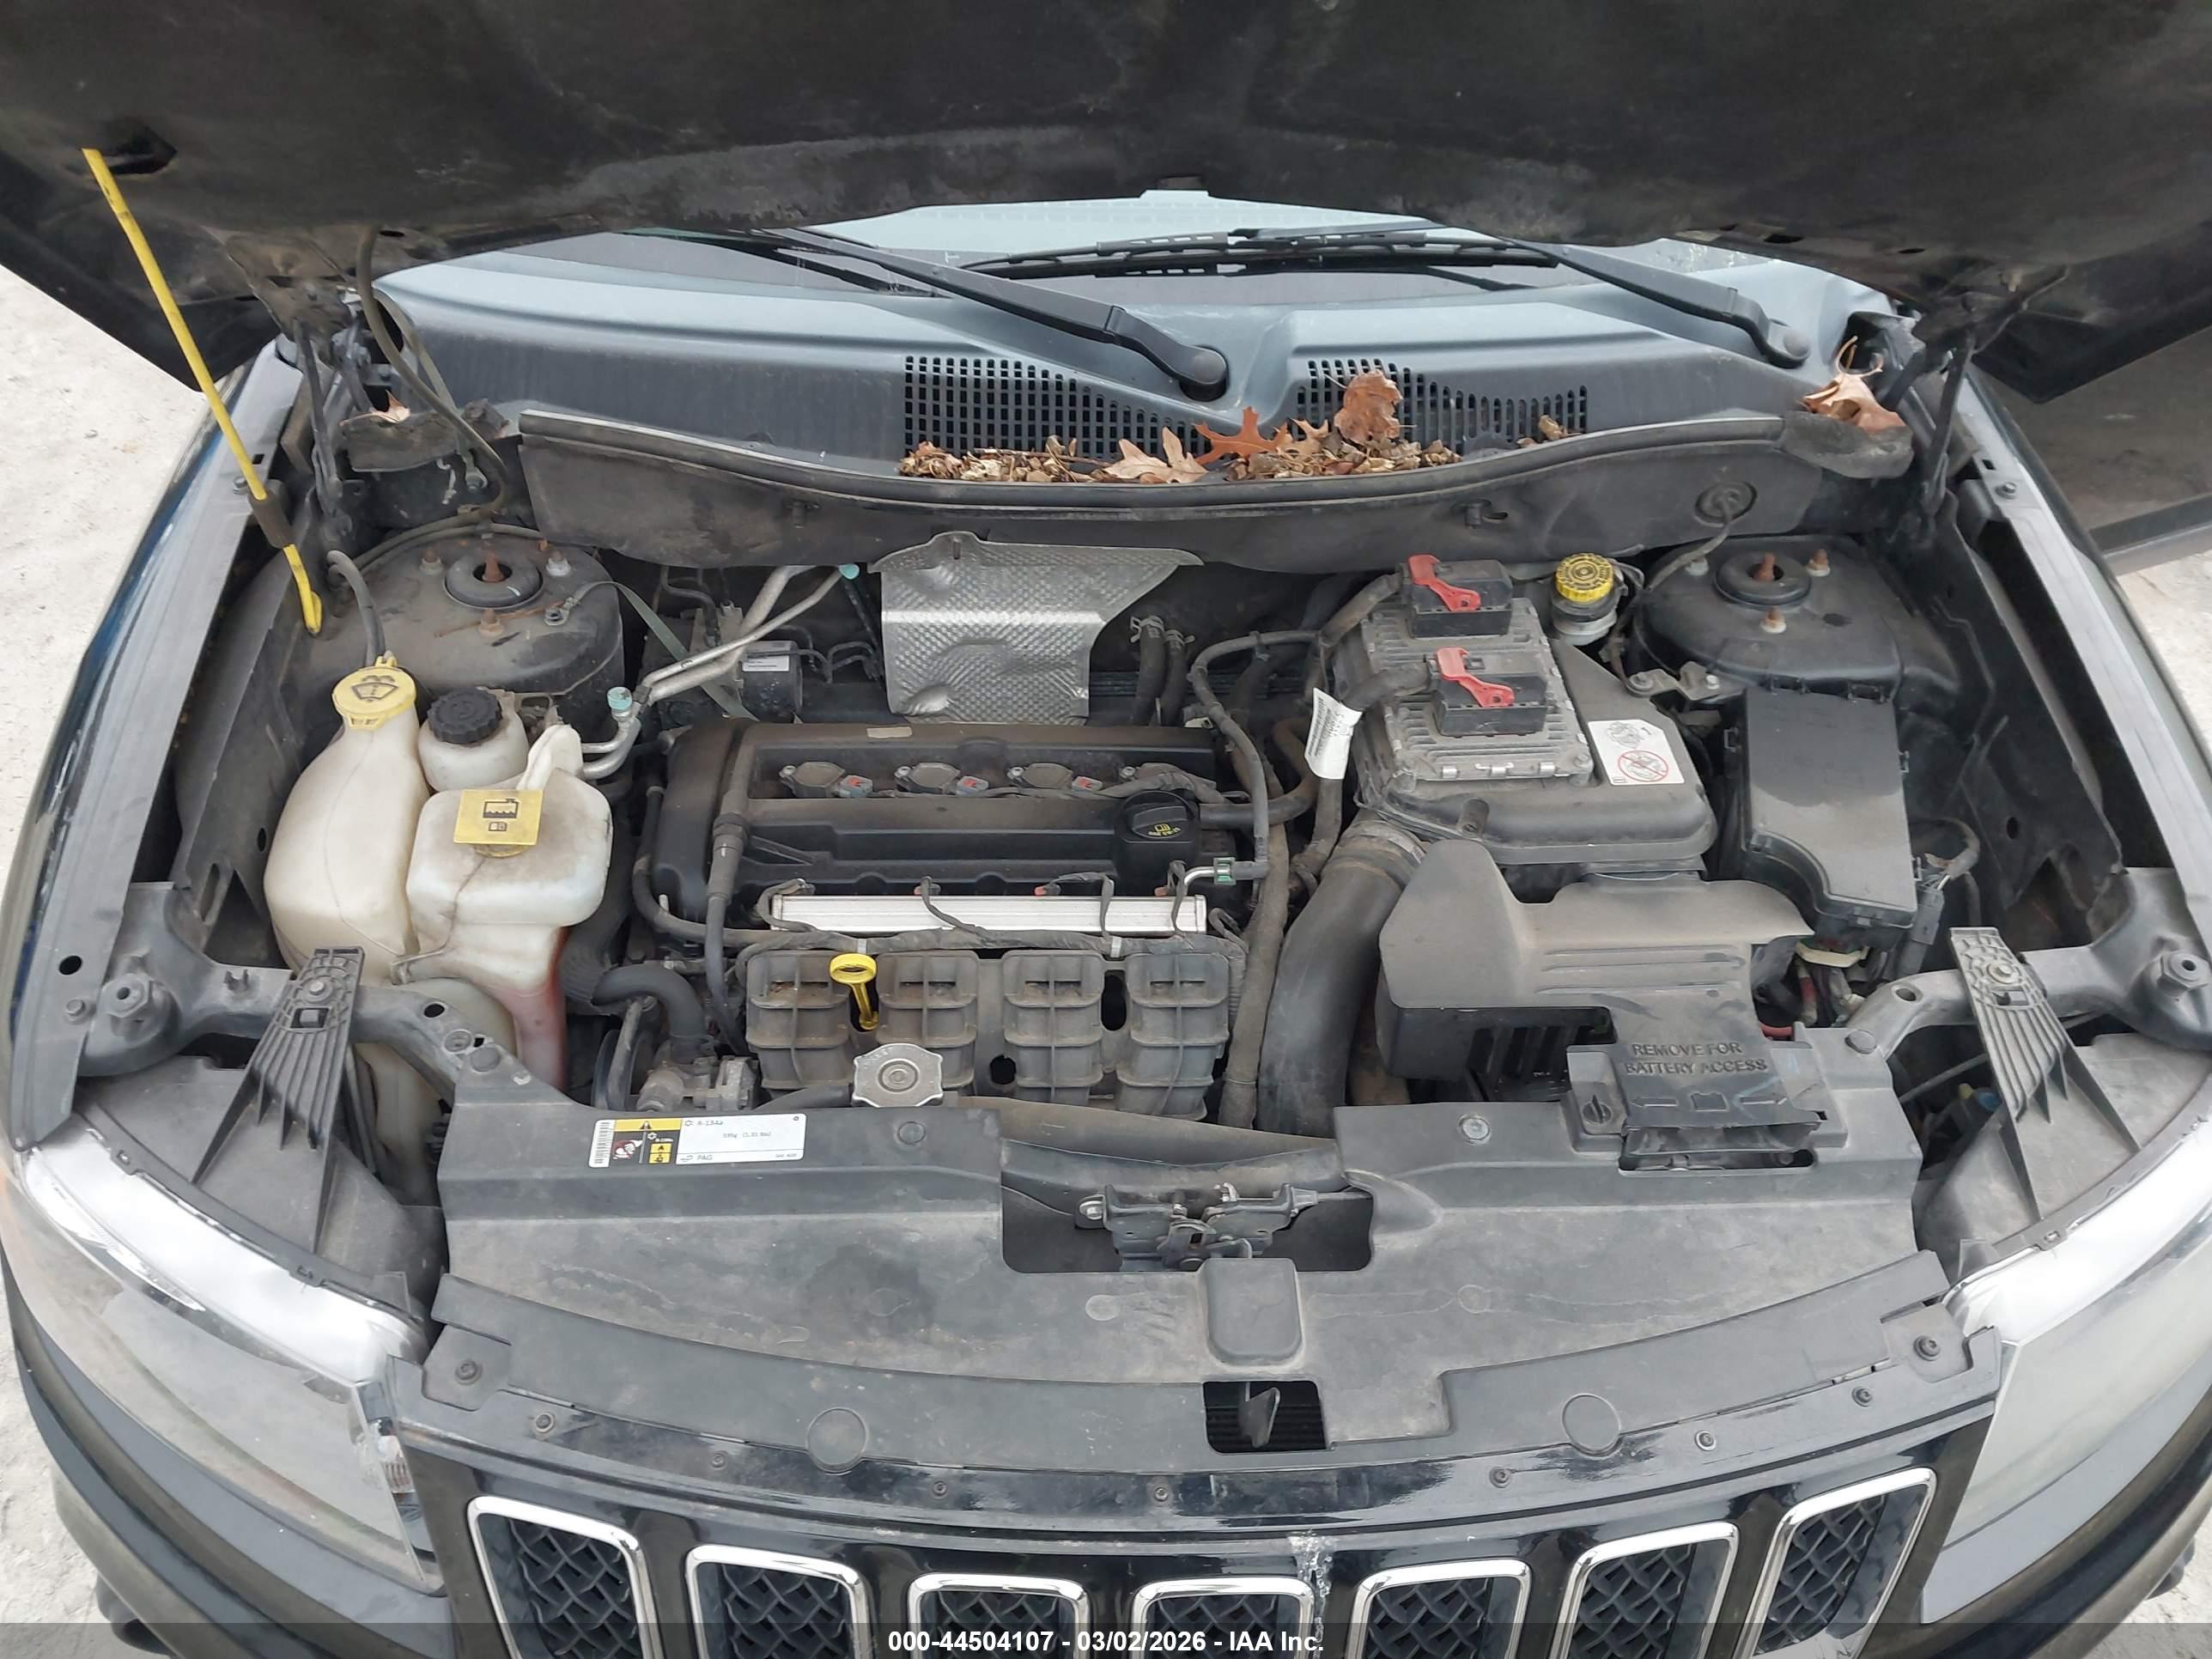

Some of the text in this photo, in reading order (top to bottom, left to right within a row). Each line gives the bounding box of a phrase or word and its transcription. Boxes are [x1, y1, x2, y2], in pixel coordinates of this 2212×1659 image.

[1632, 1041, 1743, 1057] REMOVE FOR
[1626, 1058, 1769, 1075] BATTERY ACCESS
